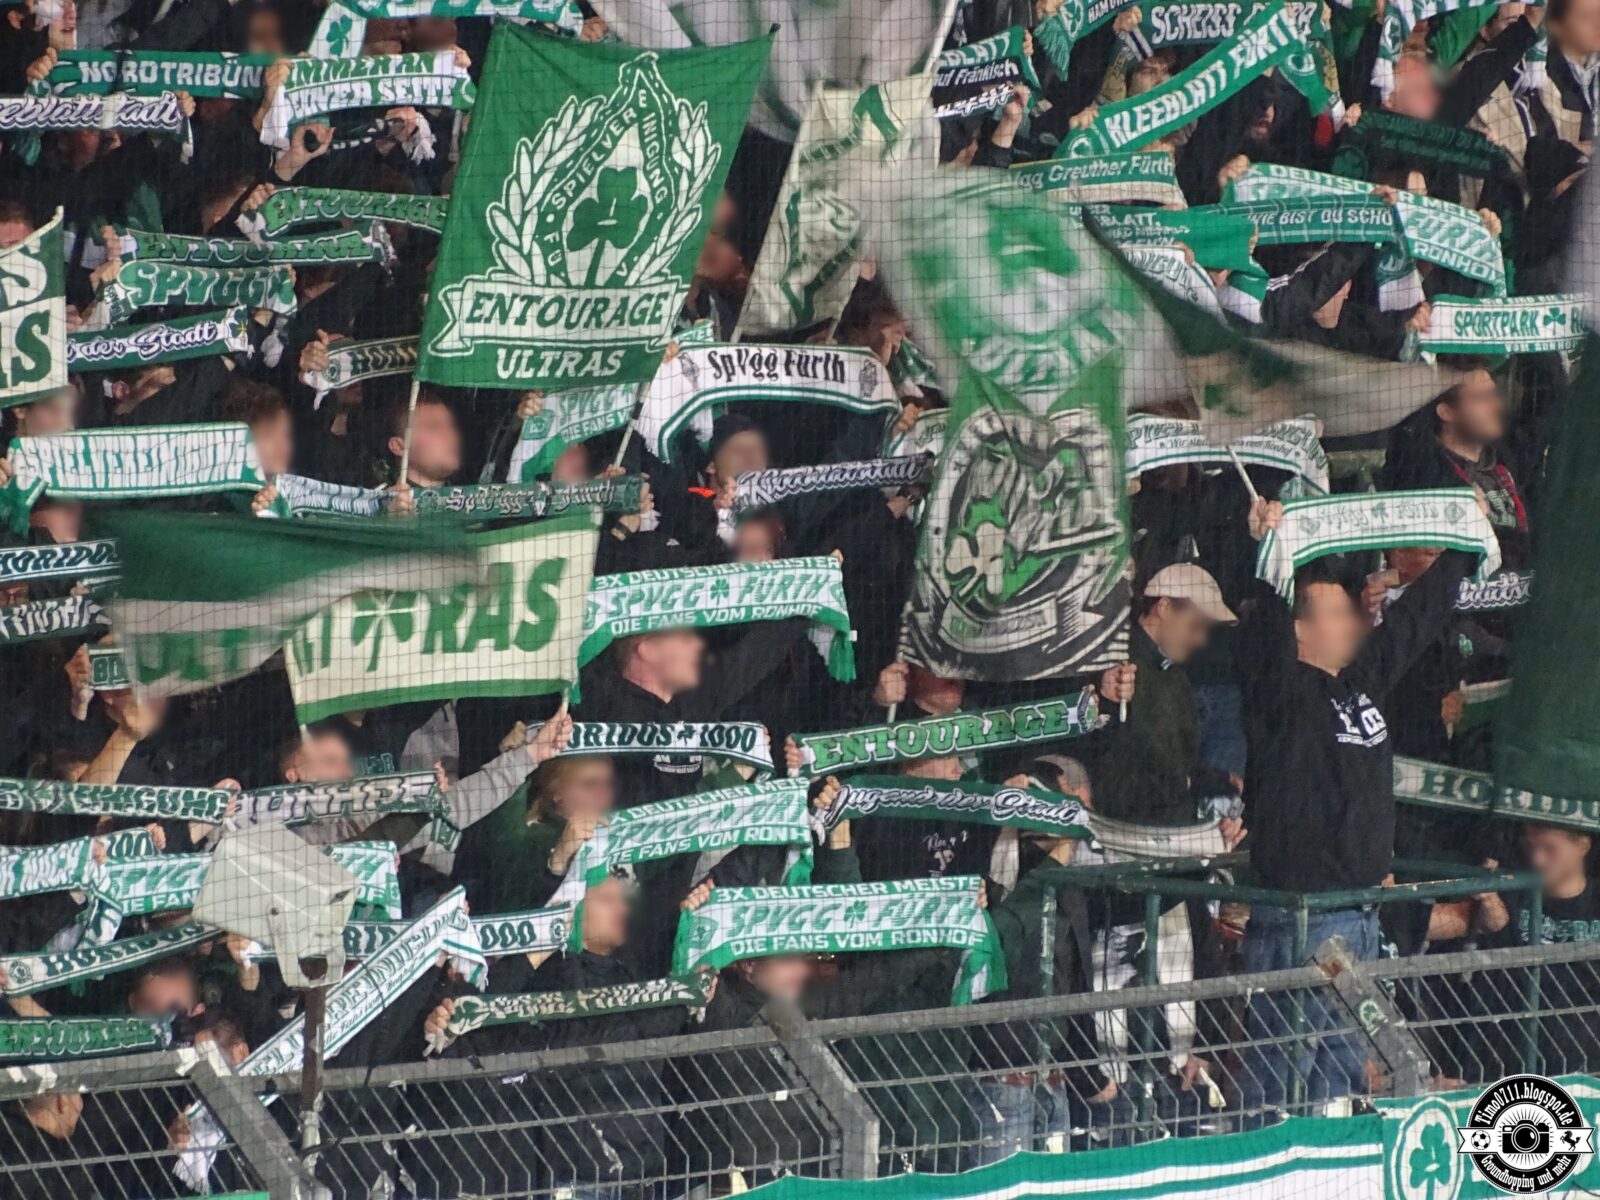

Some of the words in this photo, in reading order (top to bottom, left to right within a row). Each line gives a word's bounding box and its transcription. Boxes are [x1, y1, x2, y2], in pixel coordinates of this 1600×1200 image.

[1151, 4, 1242, 44] SCHEISS
[78, 59, 263, 88] NORDTRIBÜN
[1104, 60, 1227, 148] KLEEBLATT
[1048, 156, 1130, 183] Greuther
[1130, 155, 1174, 177] Fürth
[1347, 208, 1393, 226] SCHÖ
[465, 289, 667, 329] ENTOURAGE
[1454, 310, 1540, 337] SPORTPARK
[495, 348, 626, 380] ULTRAS
[707, 348, 778, 383] SpVgg
[611, 619, 643, 636] DIE
[703, 609, 746, 623] VOM
[699, 725, 757, 751] 1000
[804, 701, 1070, 774] ENTOURAGE
[628, 786, 751, 821] DEUTSCHER
[755, 777, 810, 794] MEIS
[824, 785, 937, 829] Jugend
[991, 787, 1081, 826] Stadt
[639, 840, 692, 860] FANS
[698, 831, 740, 847] VOM
[745, 826, 809, 843] RONH
[122, 899, 145, 914] IE
[151, 890, 199, 910] FAN
[716, 888, 749, 902] 3X
[752, 880, 889, 901] DEUTSCHER
[894, 876, 981, 892] MEISTE
[731, 938, 769, 955] DIE
[772, 933, 830, 951] FANS
[834, 931, 884, 948] VOM
[890, 929, 986, 947] RONHOF
